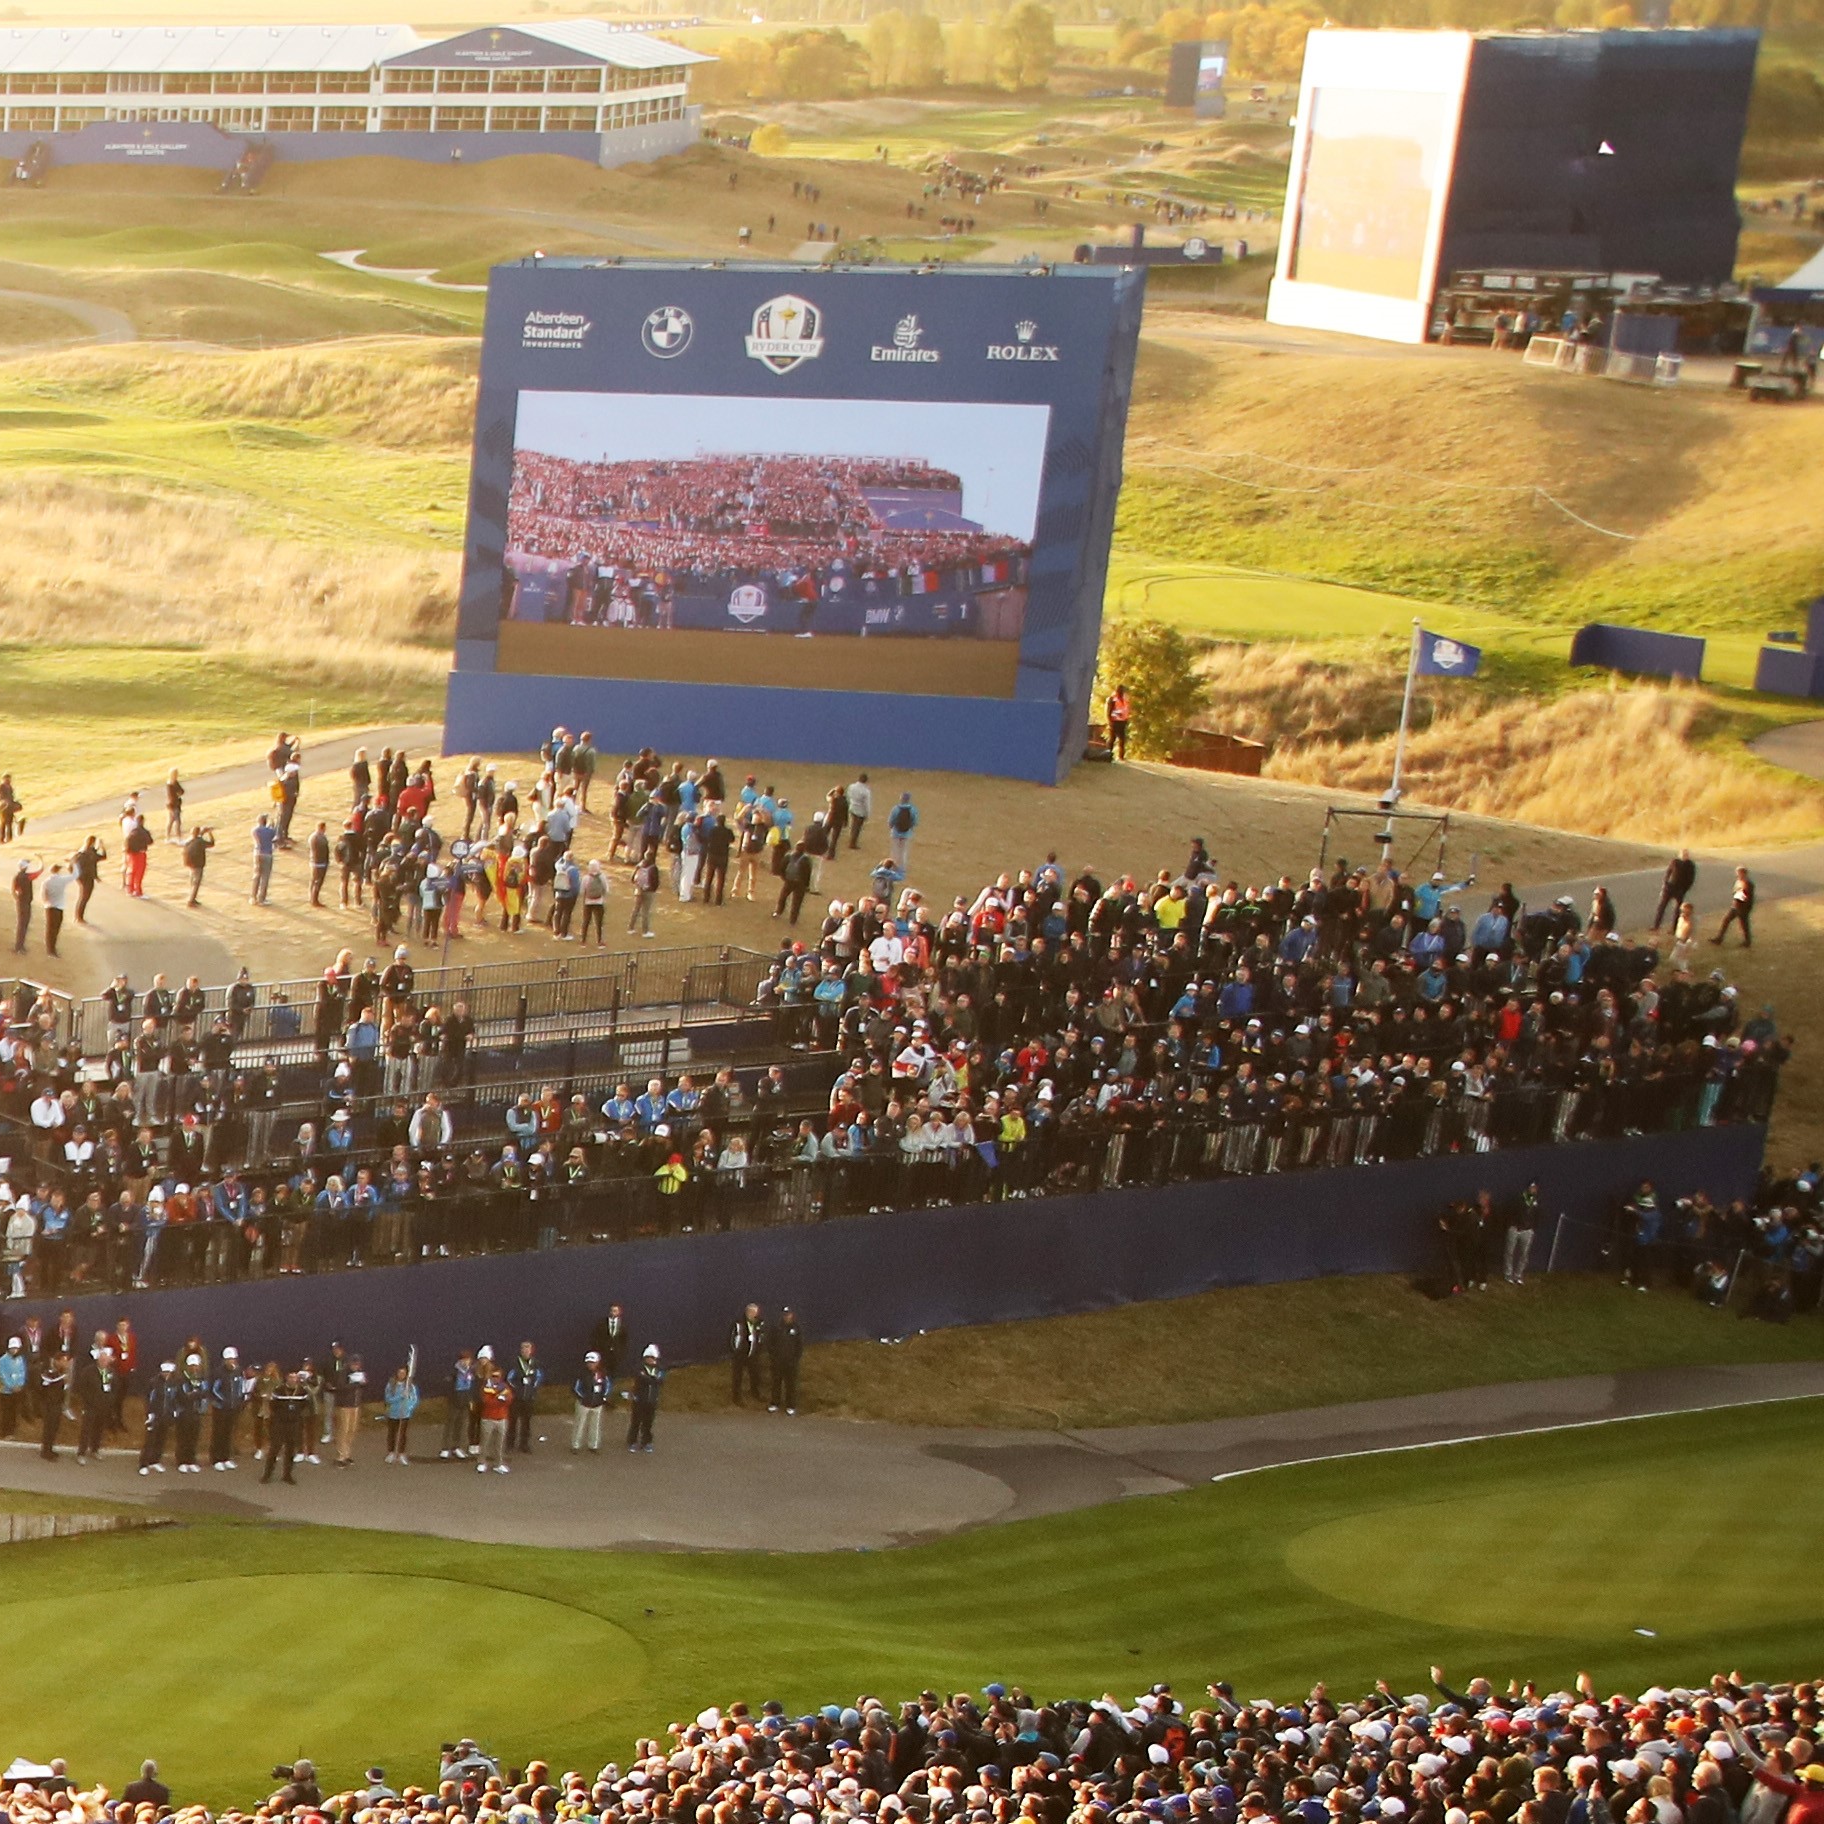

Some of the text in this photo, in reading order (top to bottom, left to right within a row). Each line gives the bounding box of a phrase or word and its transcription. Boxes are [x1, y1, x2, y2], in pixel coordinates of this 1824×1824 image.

[525, 311, 584, 324] Aberdeen
[523, 325, 583, 340] Standard
[870, 346, 939, 362] Emirates
[986, 345, 1058, 361] ROLEX
